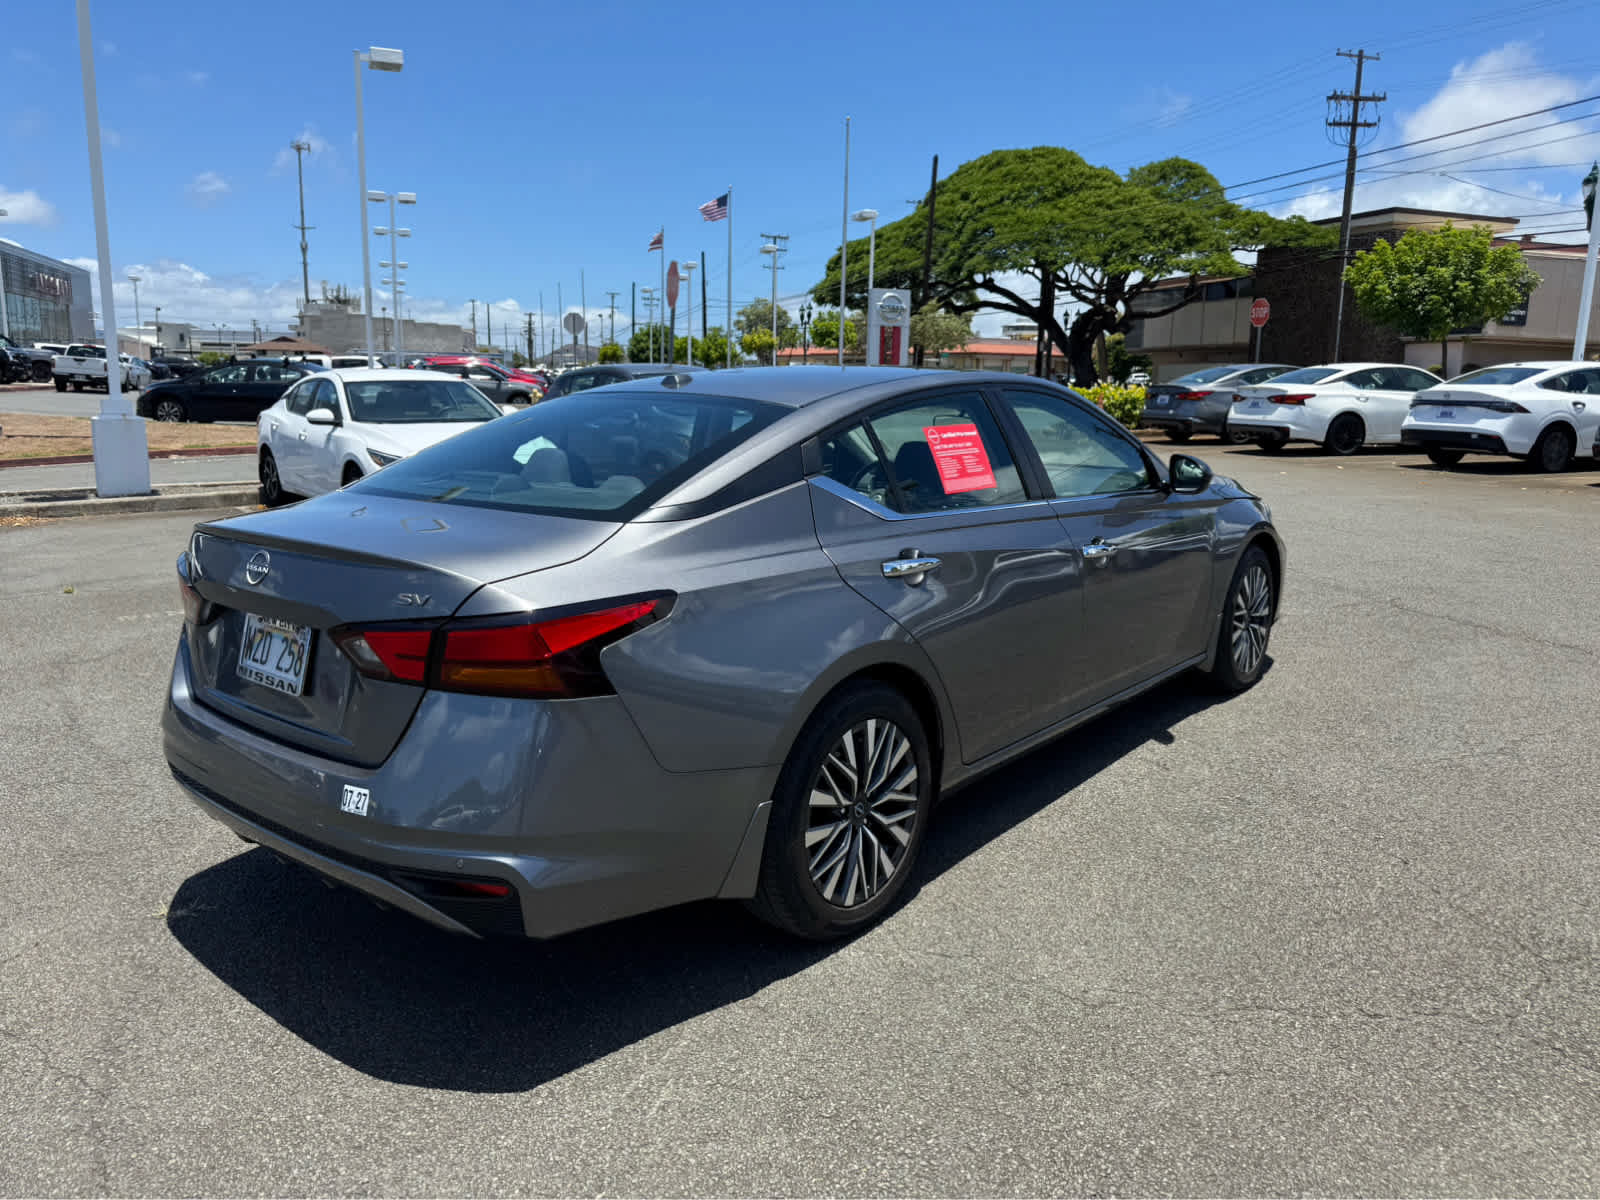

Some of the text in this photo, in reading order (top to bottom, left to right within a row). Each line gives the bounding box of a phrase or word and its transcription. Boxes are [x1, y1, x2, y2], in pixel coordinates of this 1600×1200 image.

[394, 592, 432, 608] SV
[276, 636, 304, 678] 258
[238, 666, 298, 695] NISSAN
